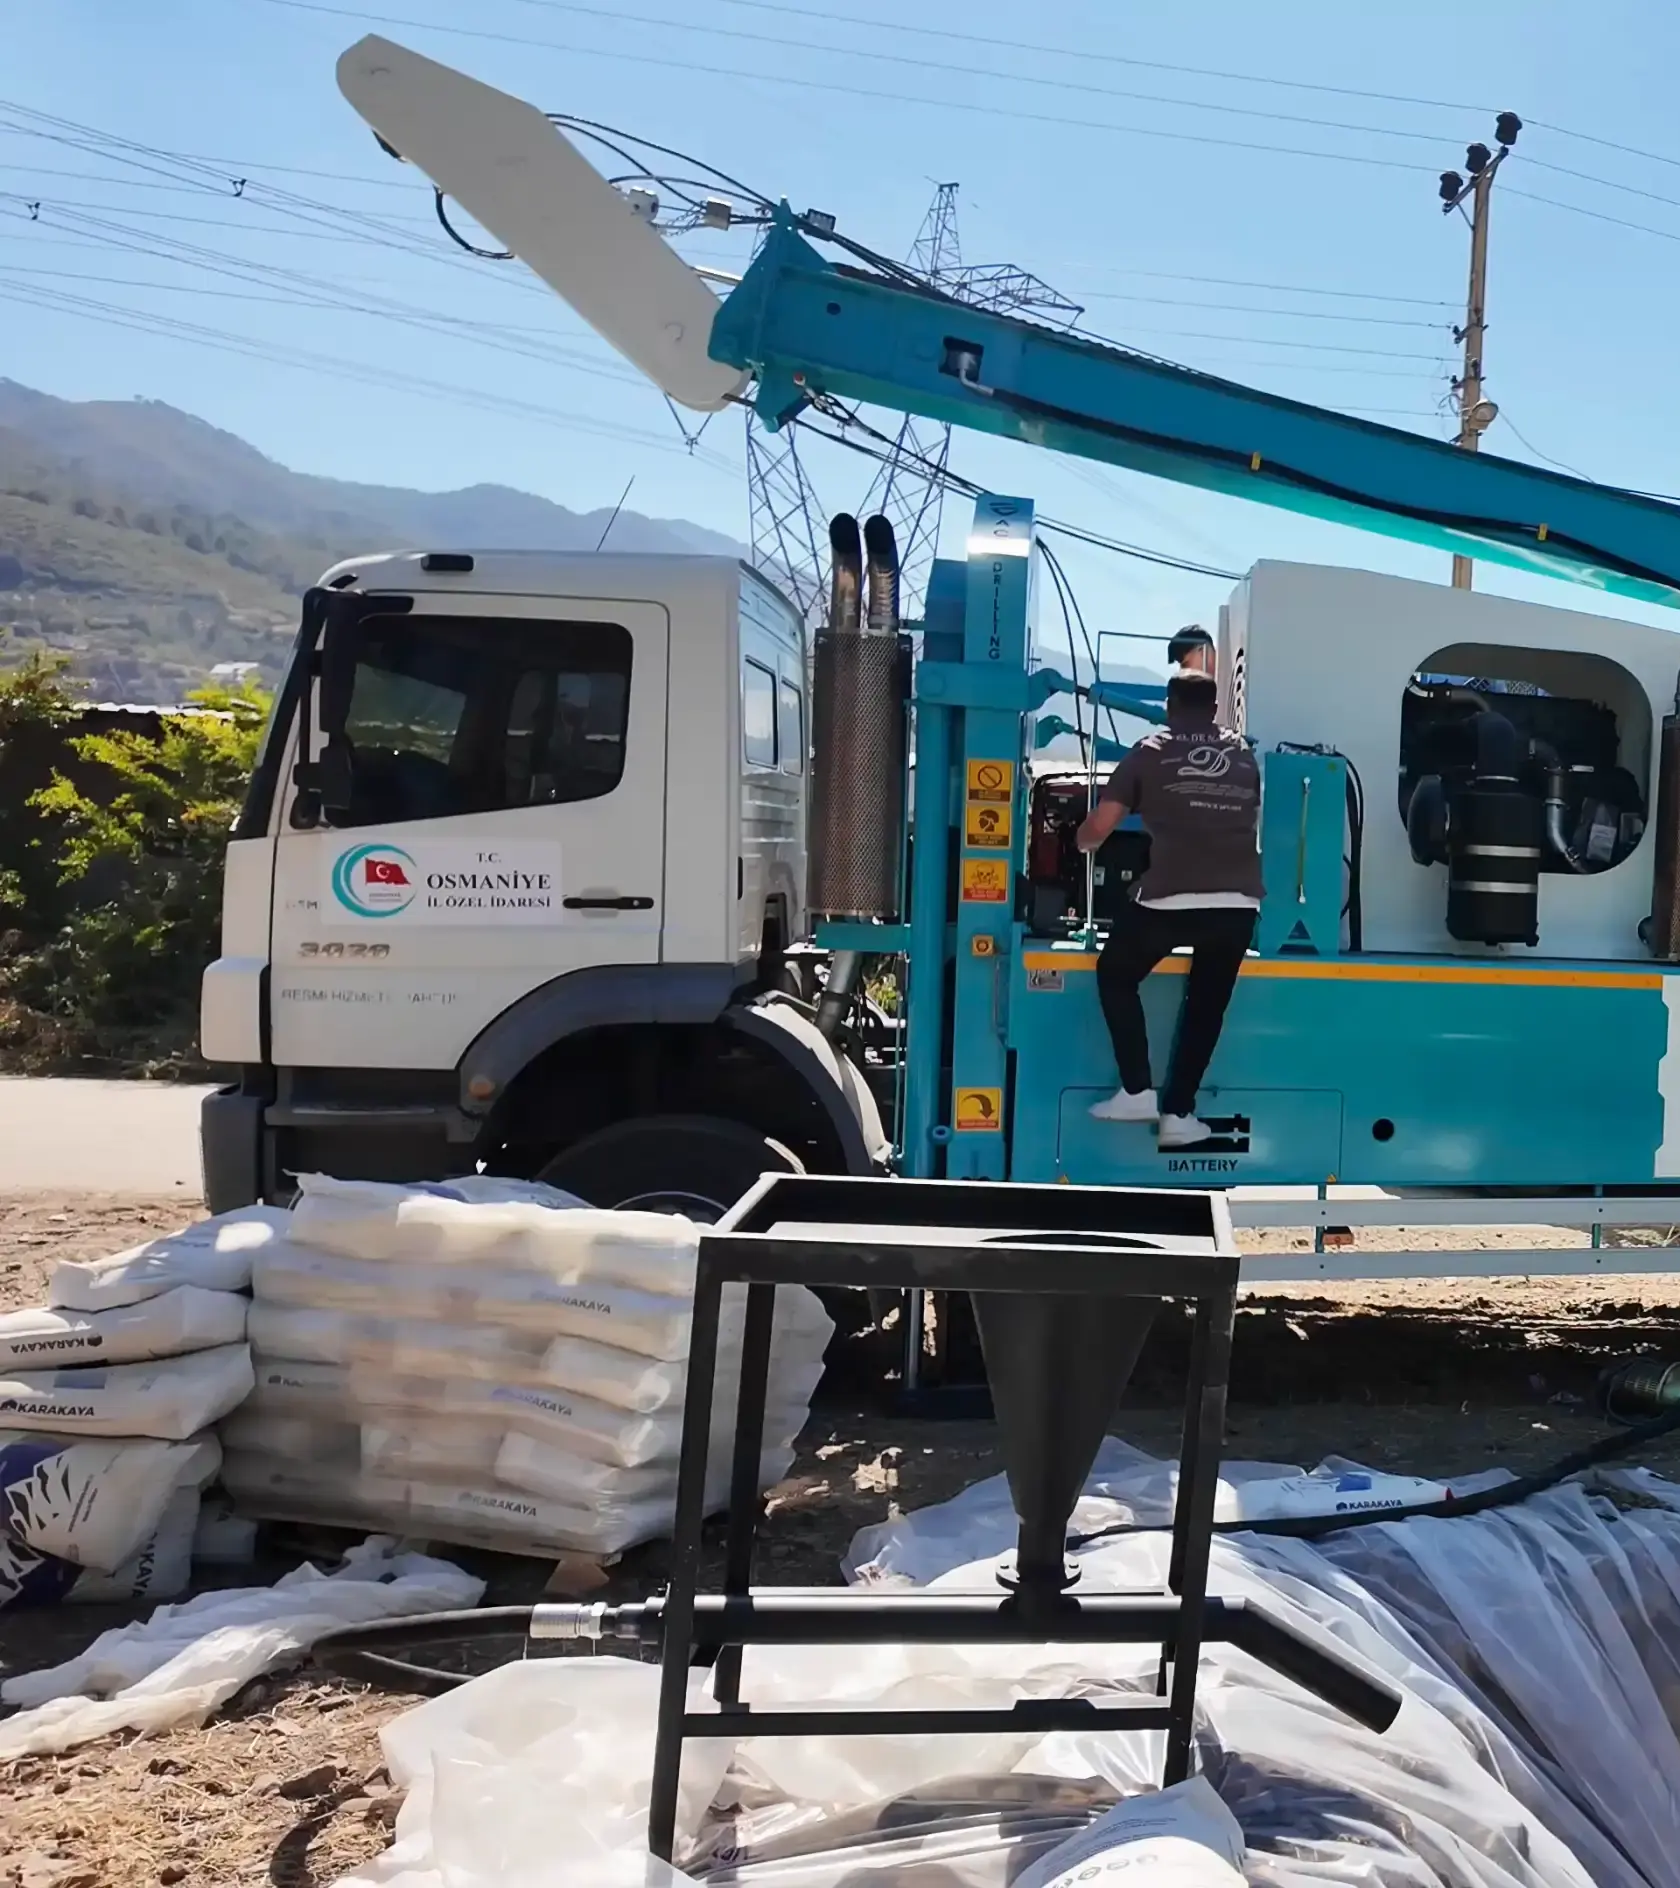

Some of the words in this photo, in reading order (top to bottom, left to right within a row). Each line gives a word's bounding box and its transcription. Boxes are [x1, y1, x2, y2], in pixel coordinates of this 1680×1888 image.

[988, 561, 1003, 660] DRILLING
[475, 852, 502, 863] T.C.
[426, 870, 551, 889] OSMANİYE
[445, 894, 488, 908] ÖZEL
[490, 894, 551, 908] İDARESİ
[1168, 1159, 1238, 1172] BATTERY
[10, 1337, 85, 1354] KARAKAYA
[17, 1402, 95, 1416] KARAKAYA
[1349, 1499, 1403, 1510] KARAKAYA
